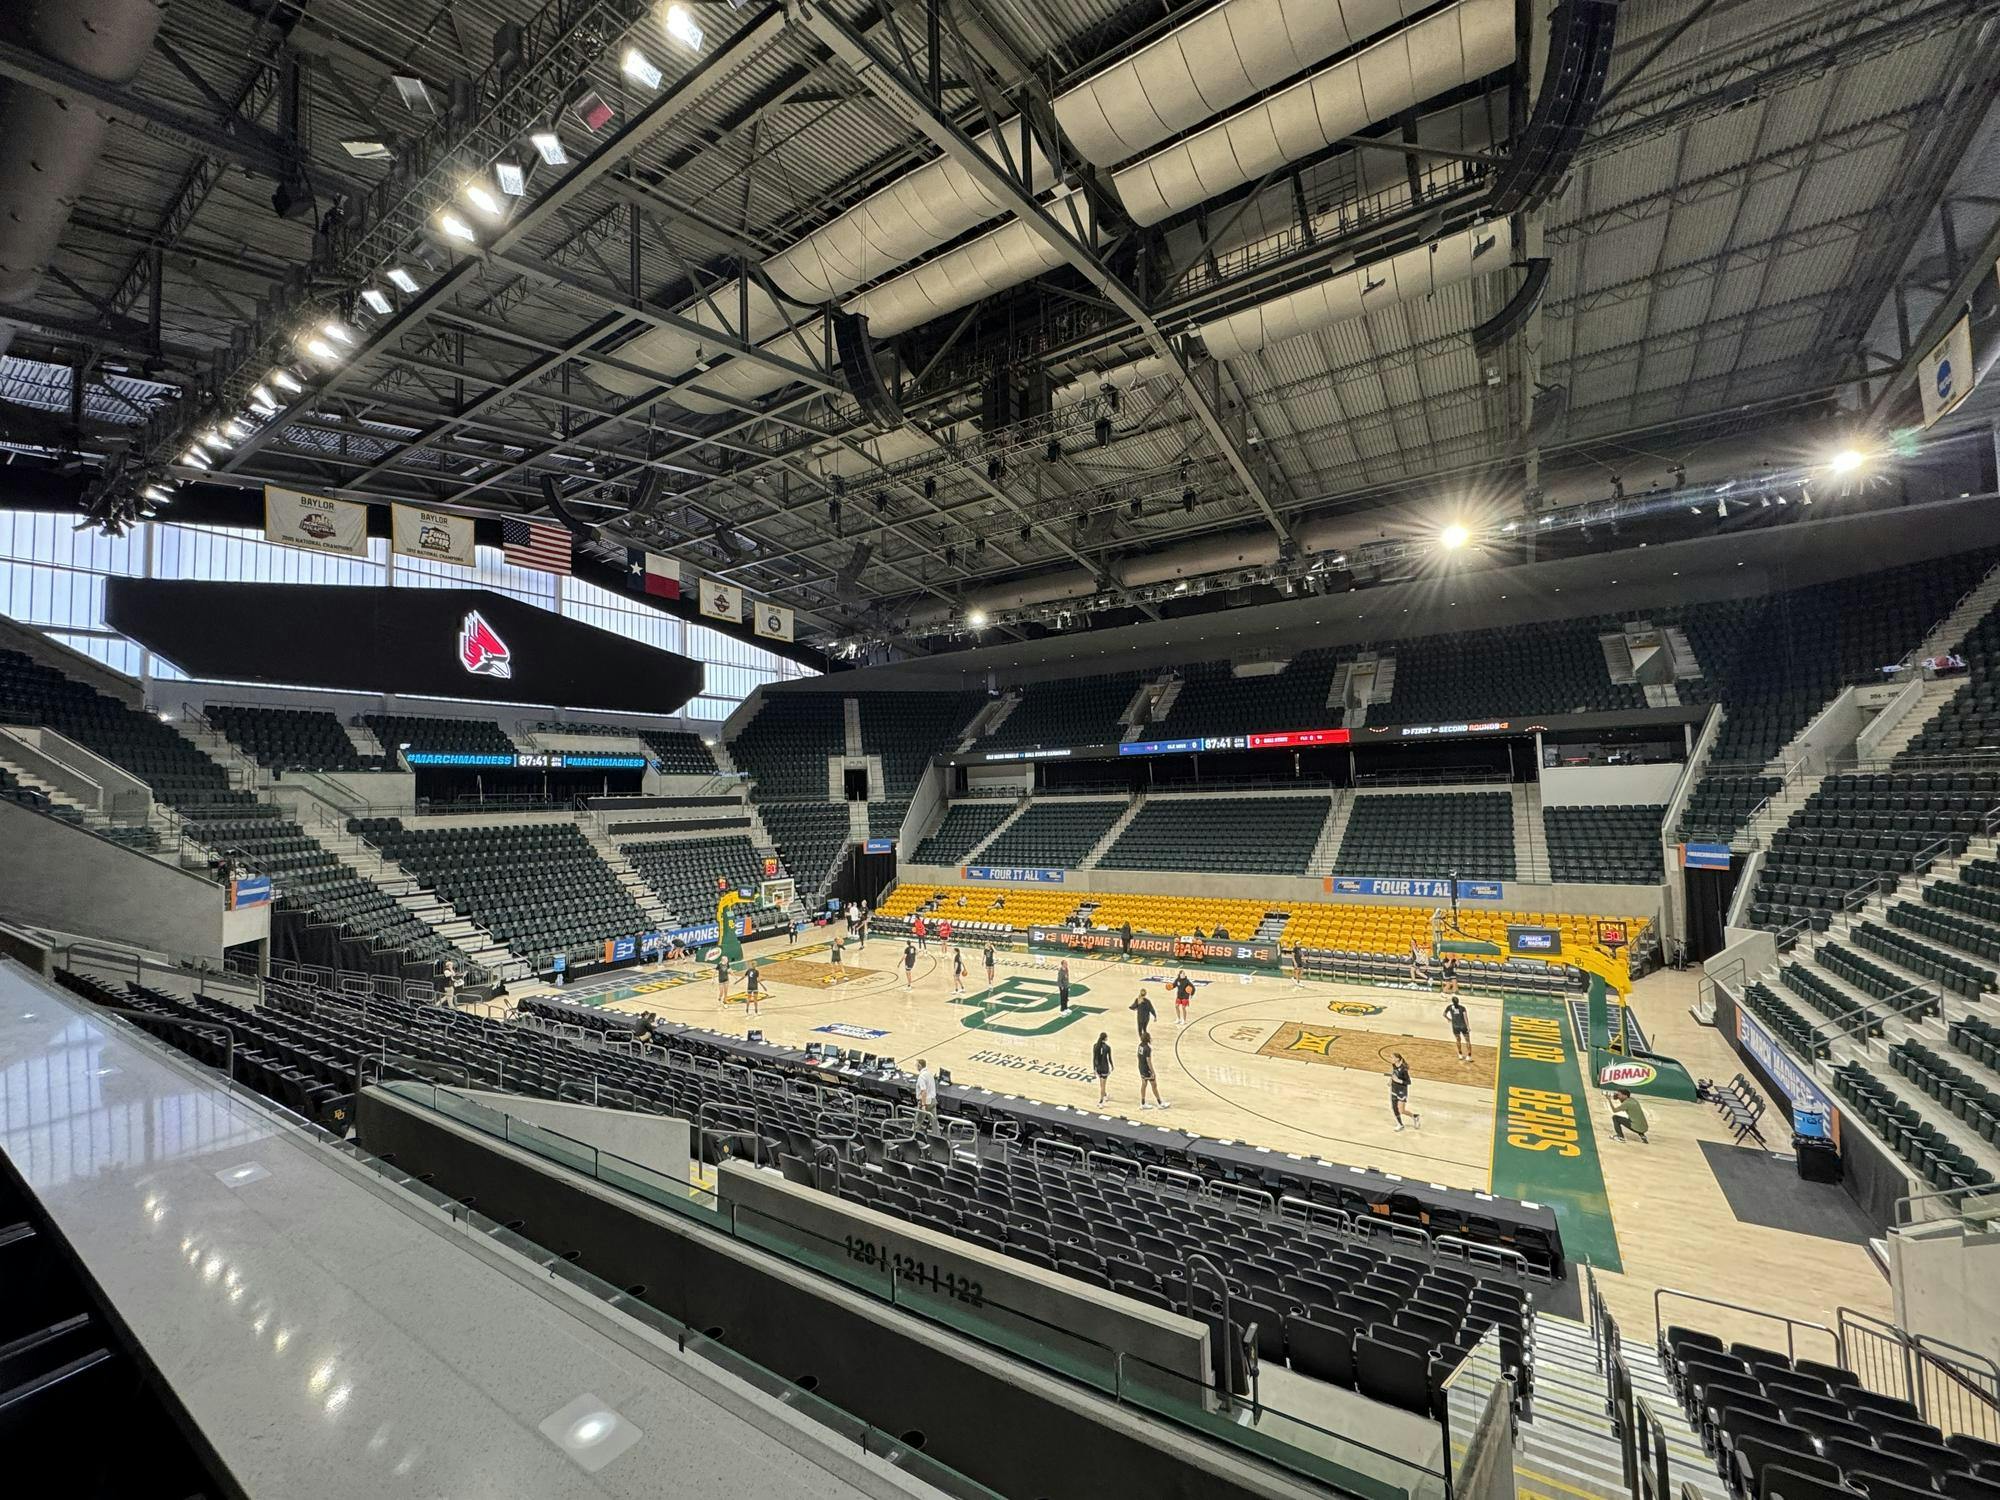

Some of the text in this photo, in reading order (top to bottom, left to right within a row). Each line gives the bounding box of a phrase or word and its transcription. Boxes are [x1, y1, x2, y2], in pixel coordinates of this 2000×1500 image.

[301, 496, 335, 510] BAYLOR
[421, 512, 448, 525] BAYLOR
[420, 532, 450, 549] FOUR
[429, 529, 450, 541] FINAL
[296, 537, 321, 547] NATIONAL
[322, 542, 353, 552] CHAMPIONS
[1411, 727, 1432, 735] FIRST
[1438, 725, 1468, 733] SECOND
[1205, 739, 1232, 749] 87:41
[407, 753, 548, 767] #MARCHMADNESS 87:41
[567, 757, 645, 767] #MARCHMADNESS
[990, 869, 1011, 880] FOUR
[1013, 870, 1023, 880] IT
[1024, 870, 1040, 881] ALL
[1373, 880, 1459, 897] FOUR IT AL
[679, 926, 721, 944] MADNES
[1605, 931, 1619, 940] 30
[1060, 933, 1110, 949] WELCOME
[1129, 940, 1170, 953] MARCH
[1509, 1015, 1565, 1064] BAYLOR
[978, 1050, 1027, 1062] MARK
[1751, 1029, 1772, 1069] MARCH
[968, 1054, 1098, 1083] HURD FLOOR
[1601, 1068, 1650, 1083] LIBMAN
[1507, 1086, 1581, 1157] BEARS
[844, 1234, 876, 1266] 120
[893, 1253, 925, 1286] 121
[946, 1272, 983, 1309] 122
